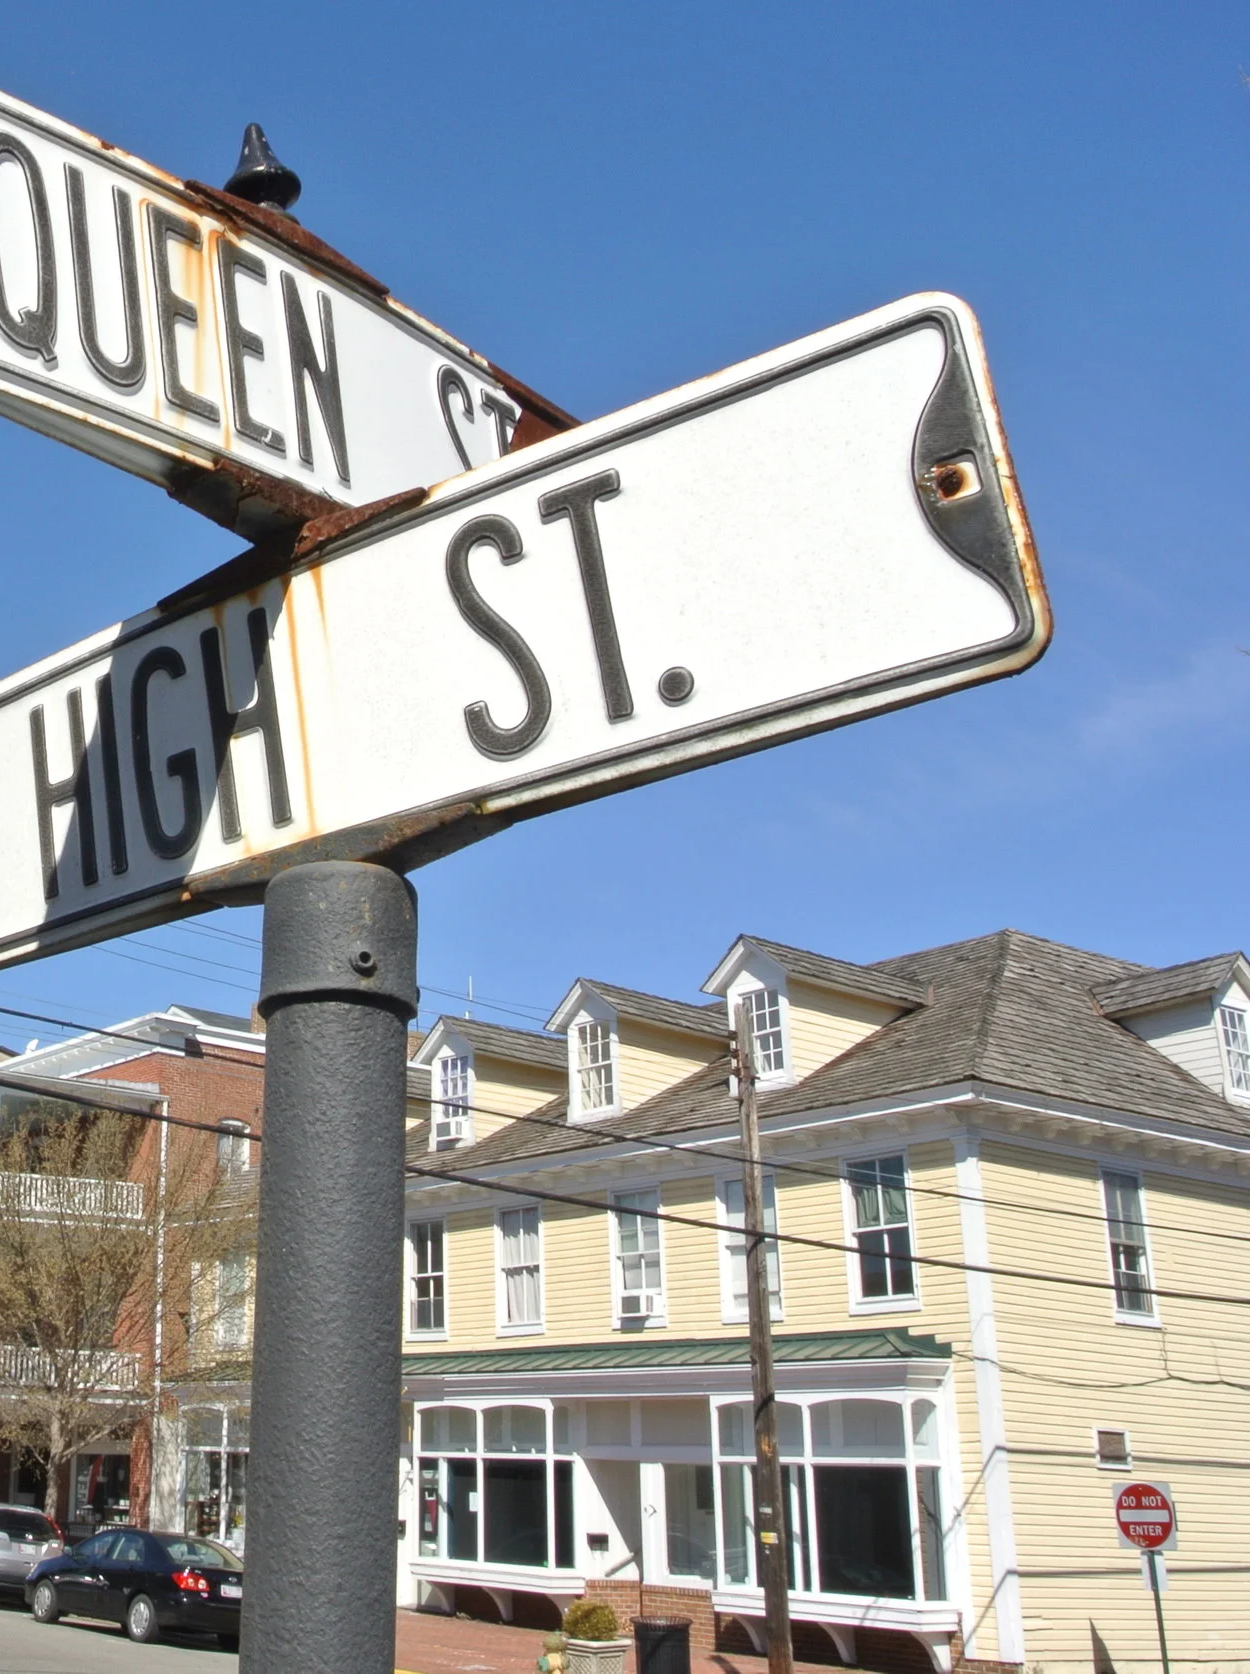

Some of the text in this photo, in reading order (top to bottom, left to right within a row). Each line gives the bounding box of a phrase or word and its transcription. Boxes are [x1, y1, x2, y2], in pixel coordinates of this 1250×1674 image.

[29, 467, 695, 900] HIGH ST.
[1121, 1495, 1162, 1507] DO NOT
[1129, 1524, 1163, 1537] ENTER
